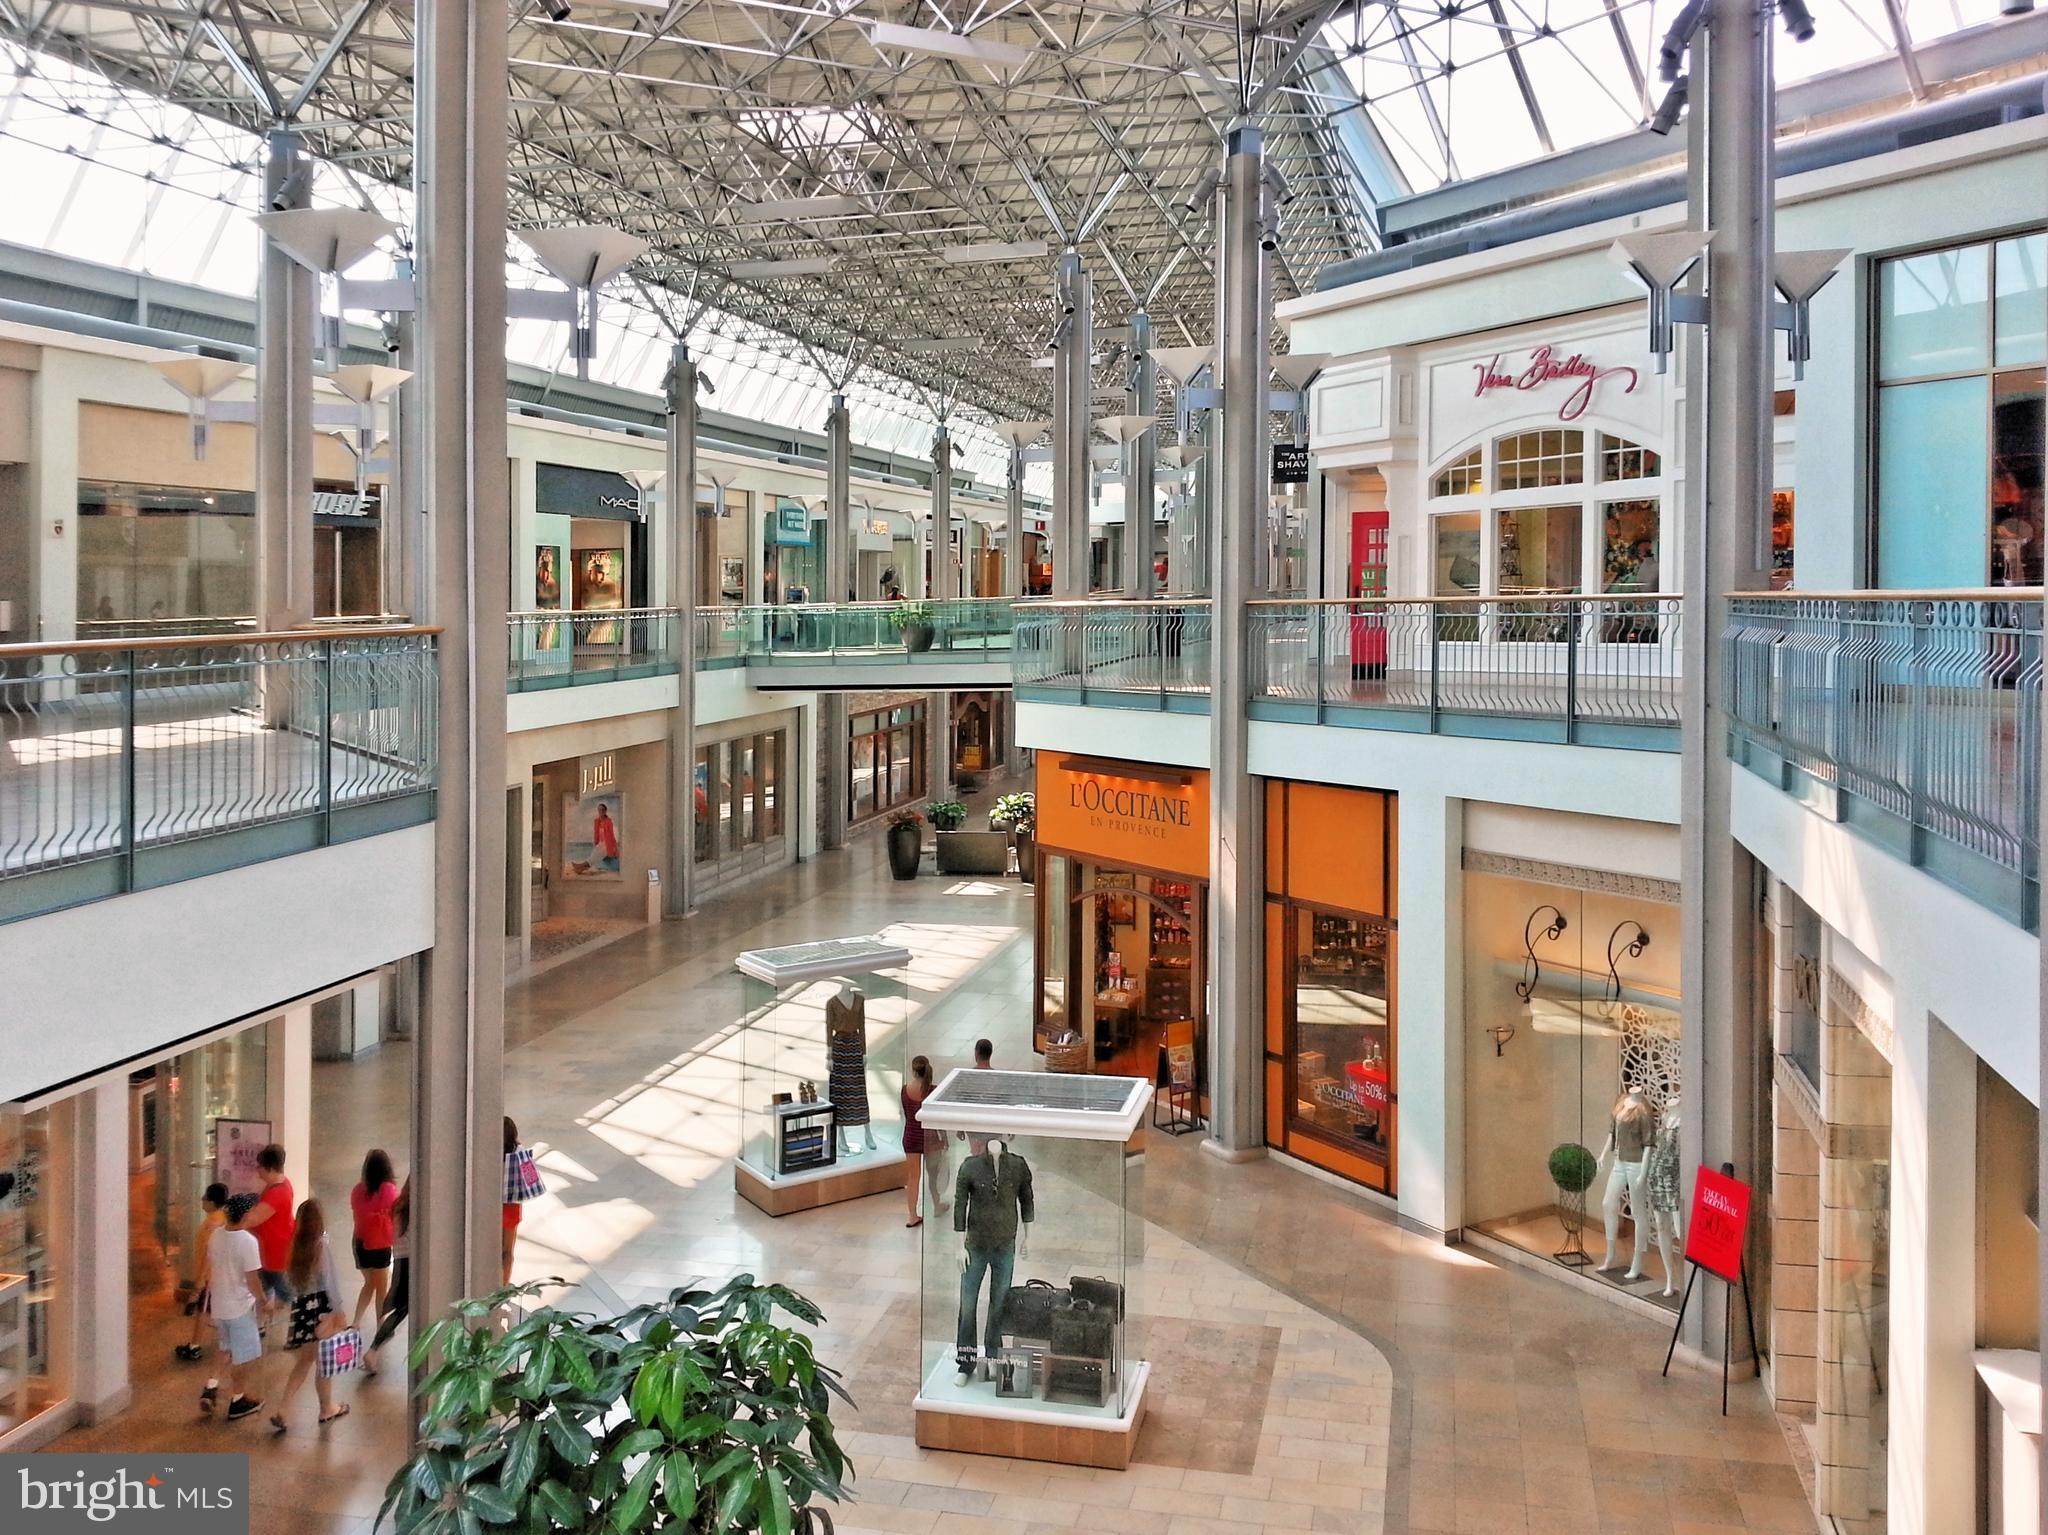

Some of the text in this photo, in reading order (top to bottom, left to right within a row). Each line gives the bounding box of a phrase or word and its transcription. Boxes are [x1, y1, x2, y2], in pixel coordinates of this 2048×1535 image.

[1473, 345, 1638, 421] Vera Bradley
[1069, 779, 1191, 827] L'OCCITANE
[1090, 815, 1167, 839] EN PROVENCE
[1317, 1081, 1366, 1106] OCCITANE
[1365, 1081, 1383, 1100] 50%
